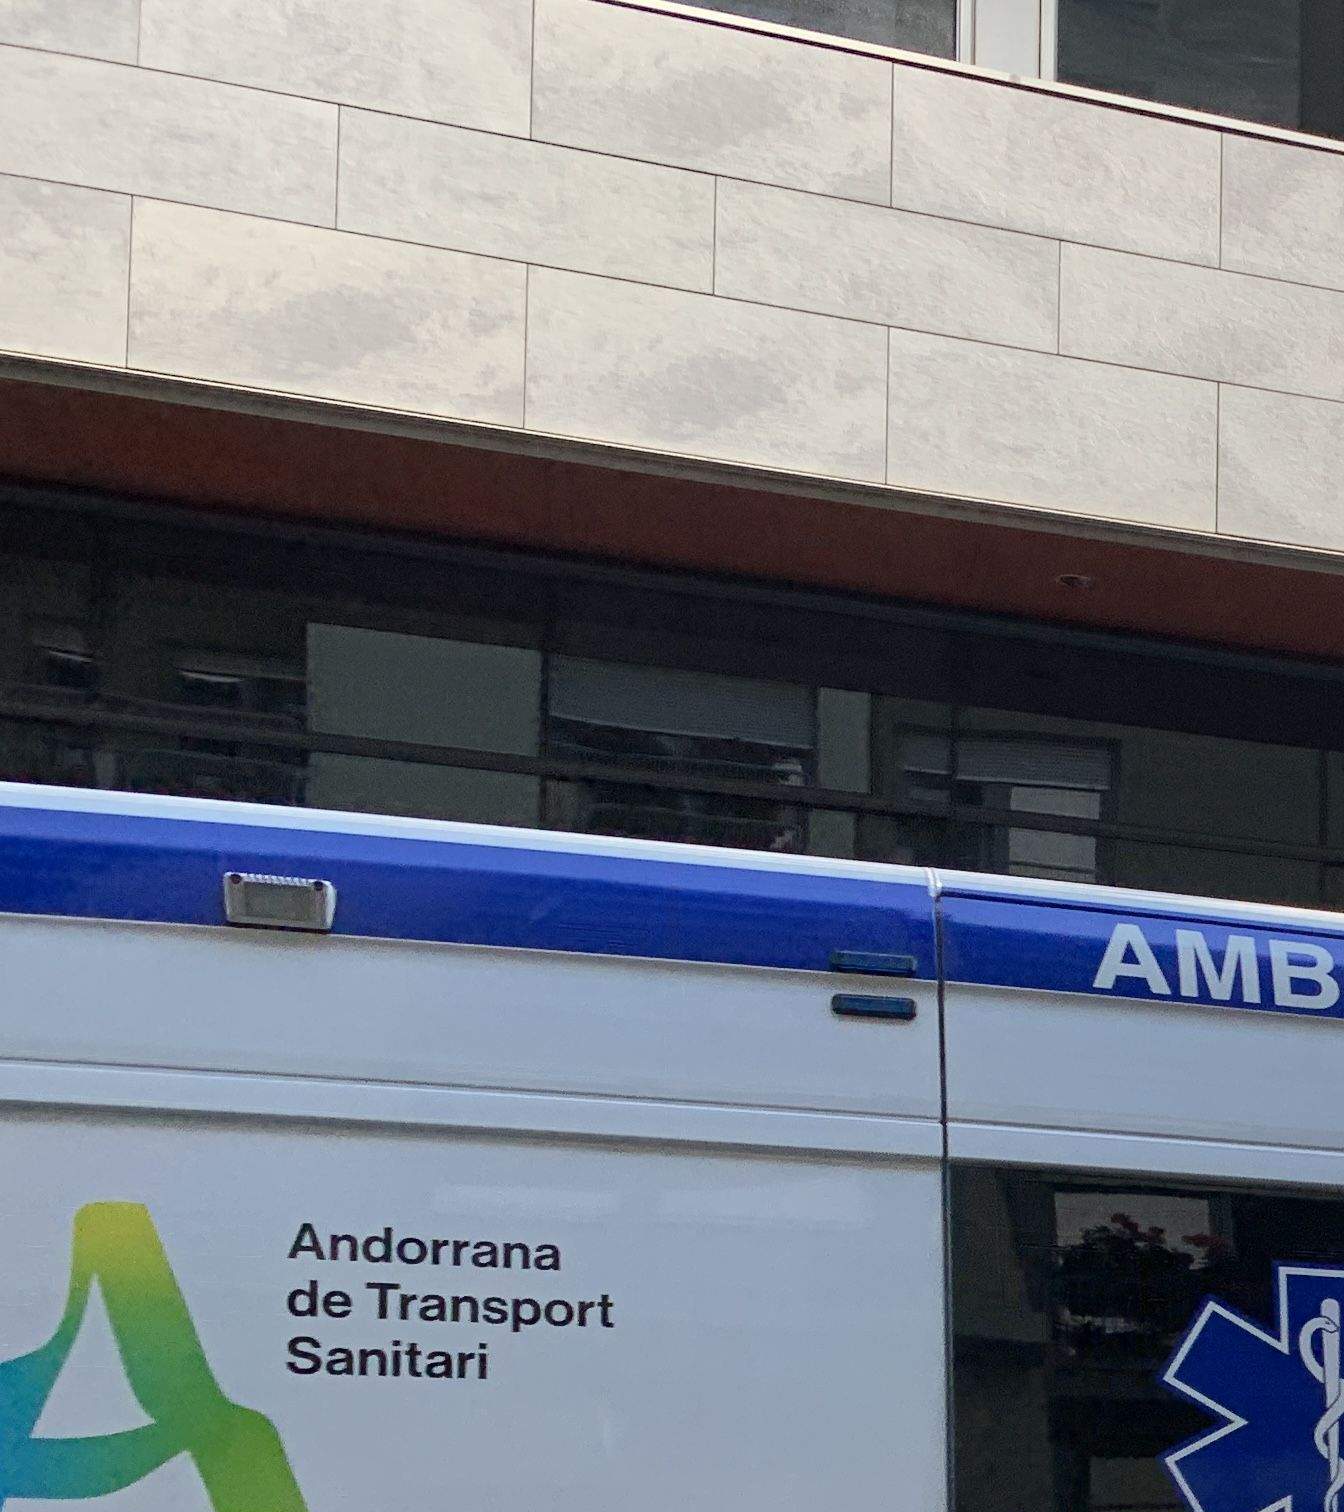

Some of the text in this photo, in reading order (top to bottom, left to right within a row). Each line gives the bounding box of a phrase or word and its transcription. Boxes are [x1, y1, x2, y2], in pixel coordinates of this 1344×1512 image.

[287, 1222, 561, 1271] Andorrana
[286, 1279, 616, 1333] de Transport
[286, 1336, 488, 1380] Sanitari
